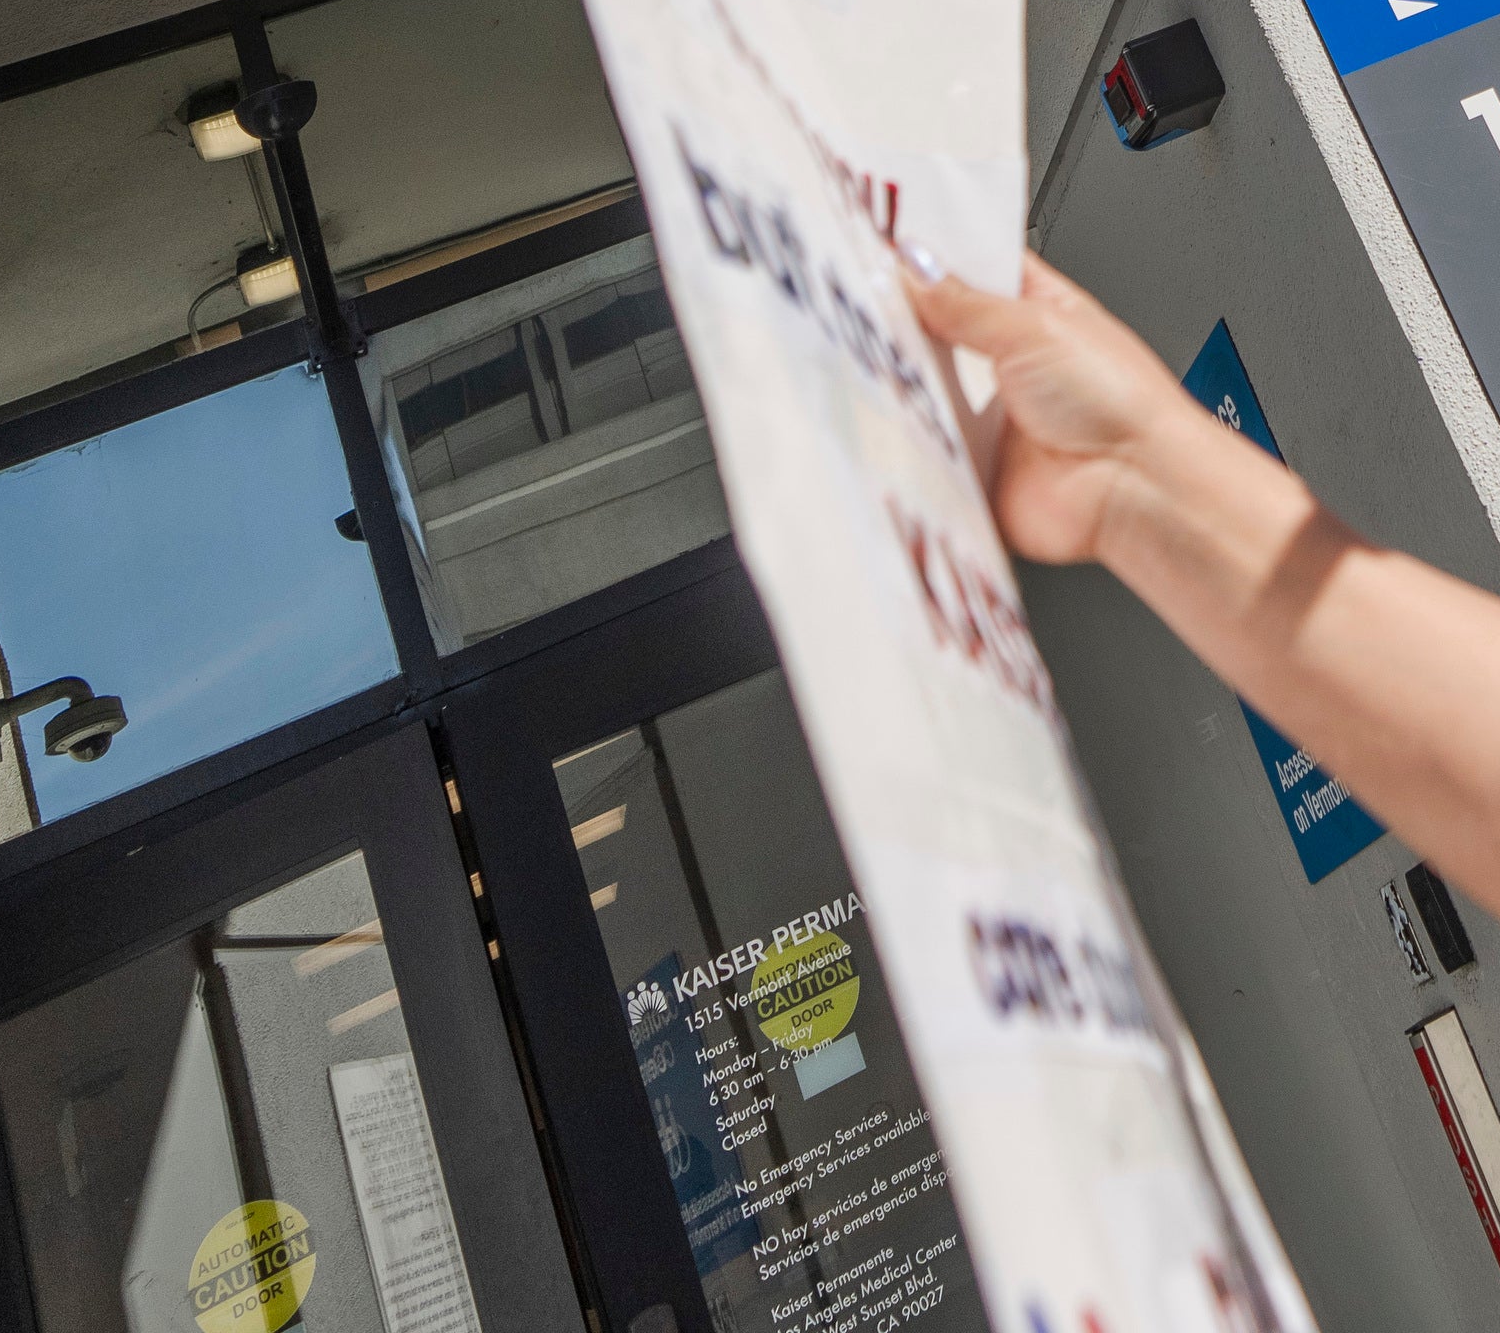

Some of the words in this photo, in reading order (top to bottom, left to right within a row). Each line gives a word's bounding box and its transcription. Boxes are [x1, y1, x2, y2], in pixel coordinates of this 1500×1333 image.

[1293, 804, 1311, 834] on
[1302, 775, 1351, 823] Vermon
[672, 937, 769, 1003] KAISER
[772, 892, 867, 955] PERMA
[683, 1001, 724, 1034] 1515
[726, 972, 793, 1012] Vermont
[797, 943, 852, 981] Avenue
[757, 958, 854, 1019] CAUTION
[791, 998, 835, 1028] DOOR
[695, 1035, 739, 1065] Hours:
[702, 1049, 757, 1088] Monday
[771, 1023, 813, 1052] Friday
[743, 1071, 764, 1088] am
[813, 1036, 833, 1062] pm
[715, 1093, 776, 1132] Saturday
[721, 1116, 768, 1152] Closed
[734, 1179, 758, 1199] No
[759, 1139, 833, 1186] Emergency
[834, 1109, 889, 1146] Services
[740, 1171, 814, 1220] Emergency
[816, 1143, 871, 1179] Services
[873, 1107, 932, 1148] available
[198, 1215, 296, 1278] AUTOMATIC
[752, 1236, 780, 1261] NO
[781, 1222, 809, 1246] hay
[812, 1192, 867, 1229] servicios
[871, 1178, 888, 1197] de
[758, 1242, 820, 1281] Servicios
[822, 1228, 840, 1246] de
[843, 1187, 918, 1235] emergencia
[194, 1233, 310, 1310] CAUTION
[232, 1281, 284, 1320] DOOR
[770, 1290, 814, 1324] Kaiser
[816, 1247, 894, 1297] Permanente
[804, 1292, 858, 1331] Angeles
[860, 1254, 913, 1298] Medical
[915, 1234, 957, 1265] Center
[860, 1291, 904, 1322] Sunset
[906, 1266, 939, 1296] Blvd.
[877, 1314, 900, 1333] CA
[902, 1284, 945, 1322] 90027
